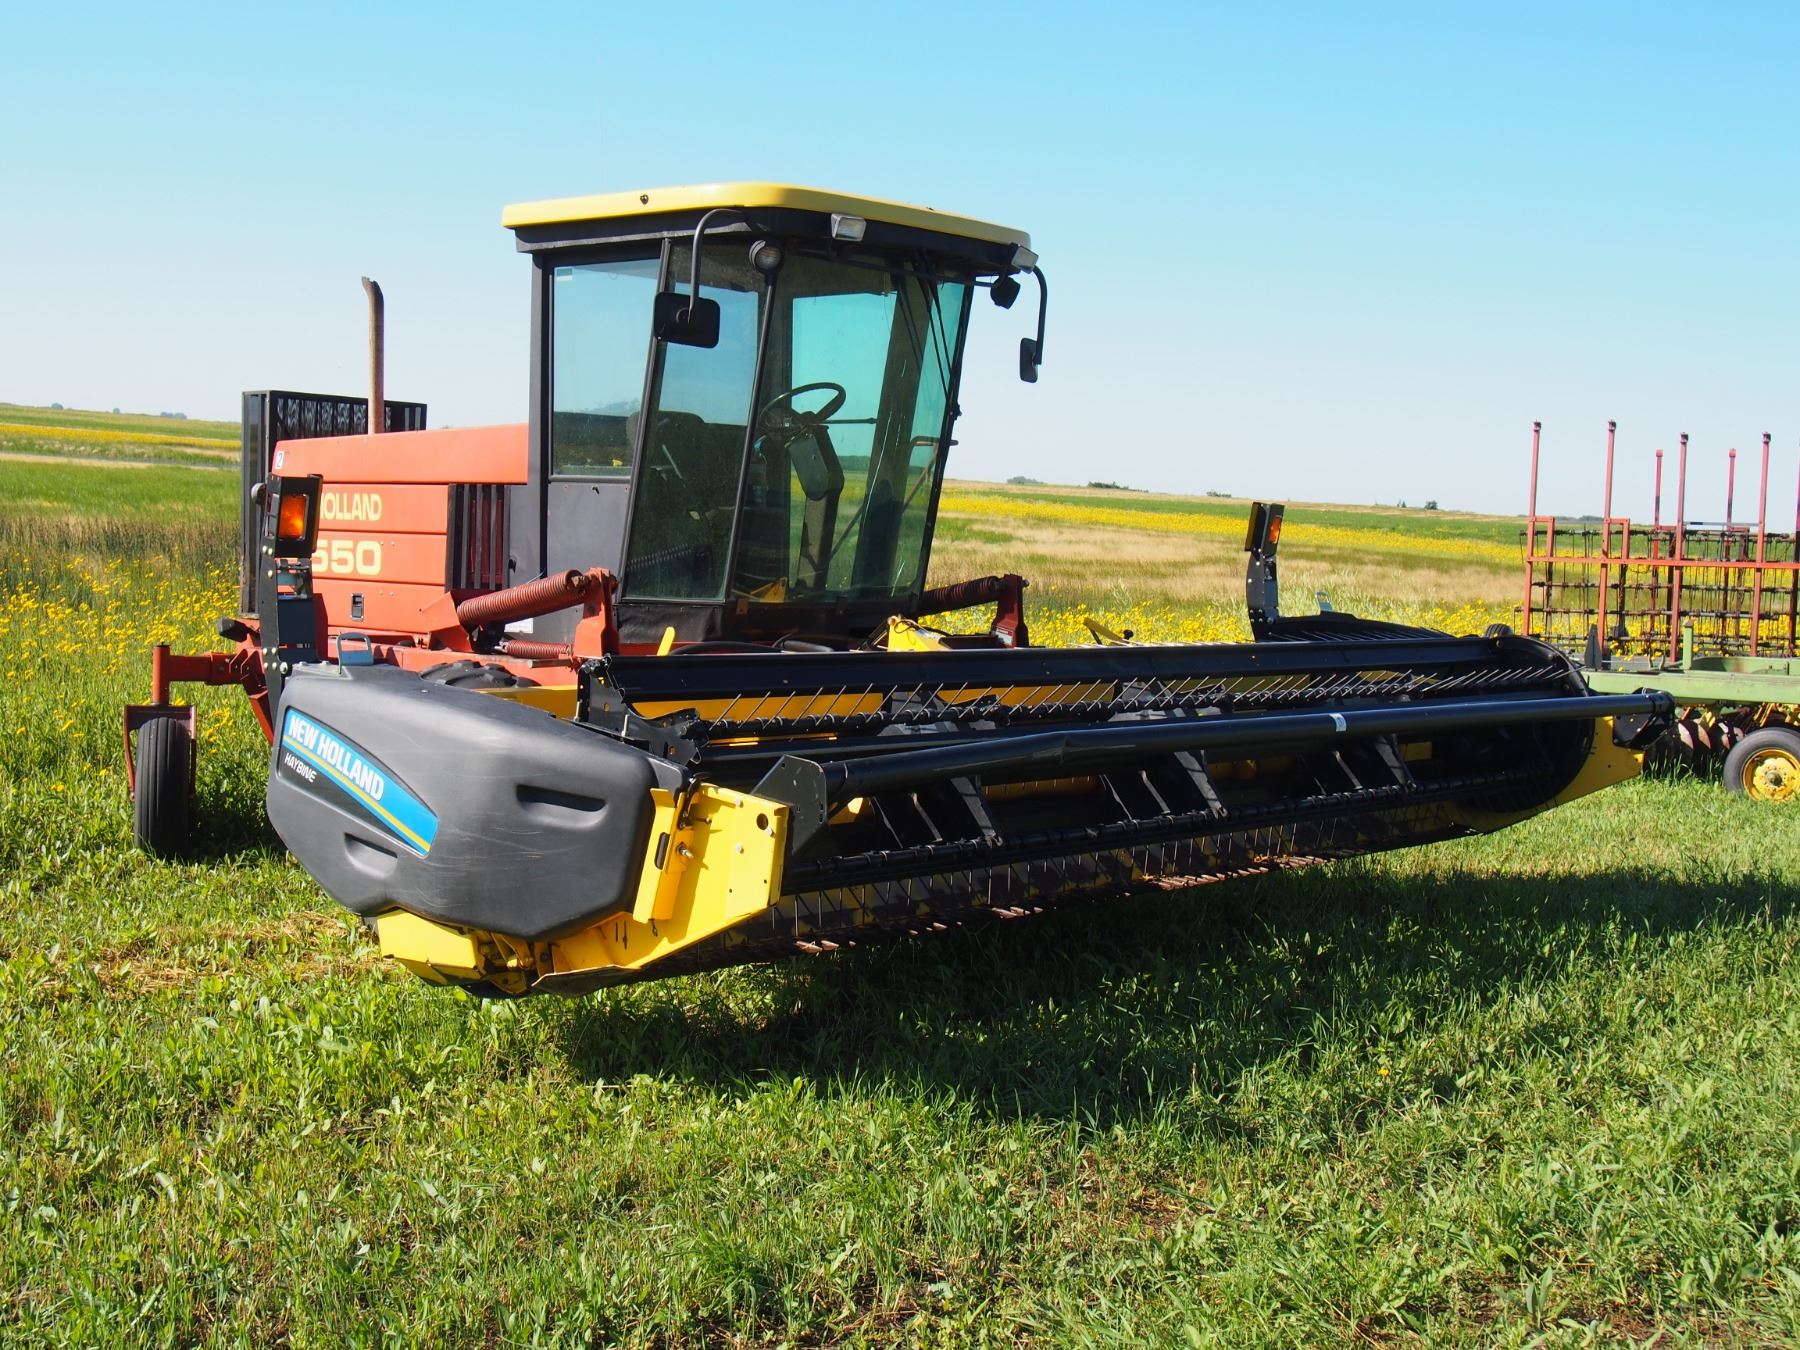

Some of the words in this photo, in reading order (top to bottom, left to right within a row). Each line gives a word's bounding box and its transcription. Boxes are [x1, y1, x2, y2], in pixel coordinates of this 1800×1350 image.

[284, 752, 317, 783] HAYBINE
[288, 714, 319, 750] NEW
[317, 733, 384, 801] HOLLAND
